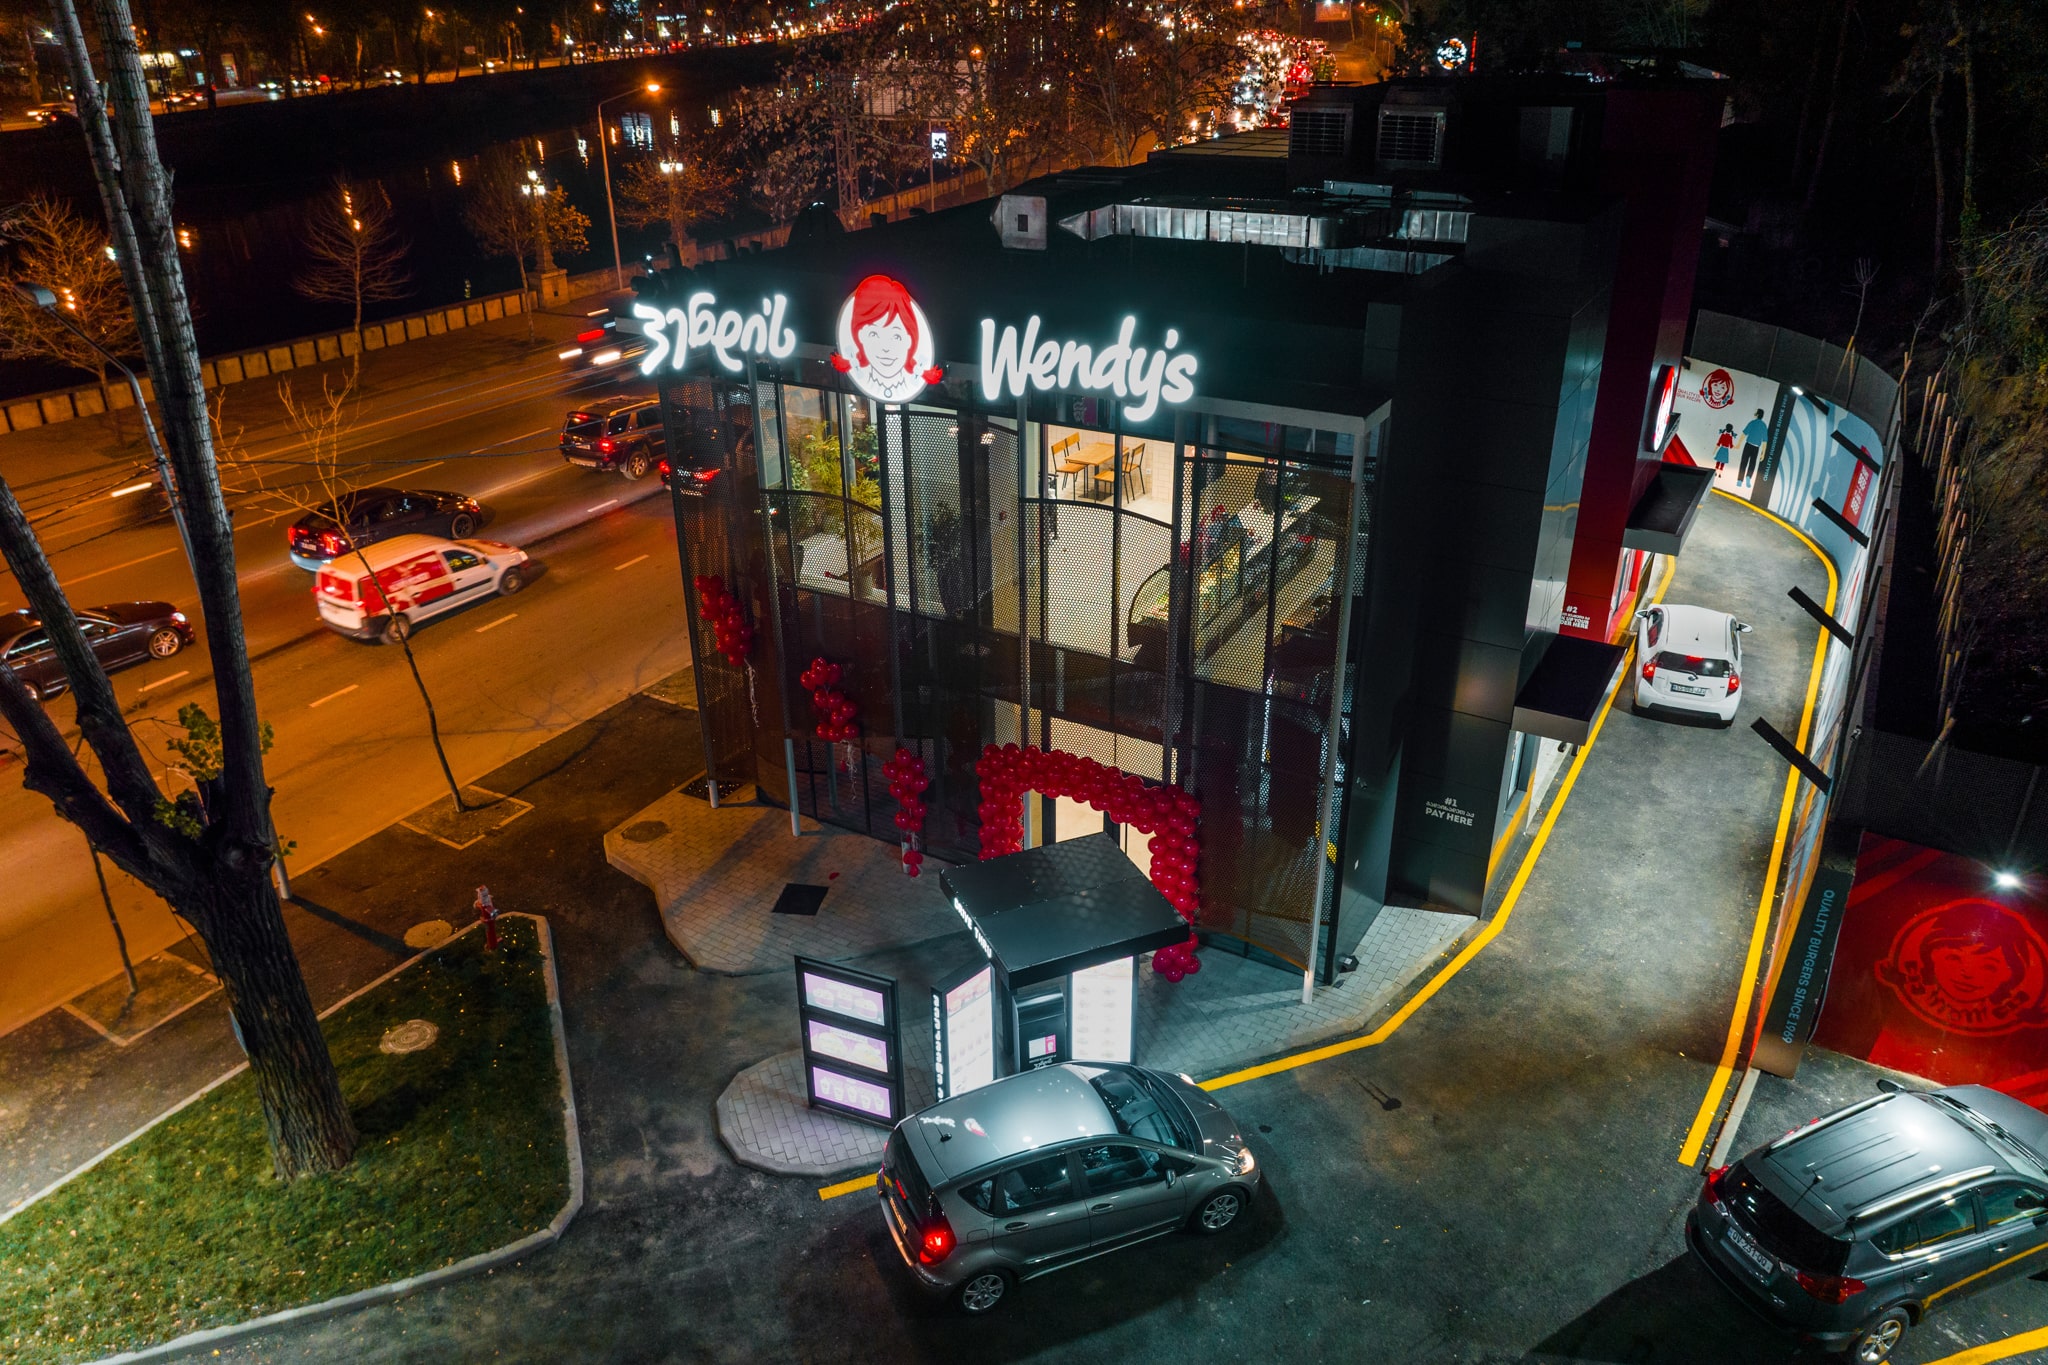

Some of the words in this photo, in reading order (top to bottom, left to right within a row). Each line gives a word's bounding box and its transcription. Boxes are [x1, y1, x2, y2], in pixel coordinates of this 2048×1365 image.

[981, 315, 1198, 423] Wendy's
[1763, 455, 1773, 481] QUALITY
[1776, 408, 1785, 428] SINCE
[1566, 605, 1578, 614] #2
[1425, 807, 1446, 818] PAY
[1446, 813, 1473, 826] HERE
[1444, 797, 1457, 807] #1
[954, 897, 973, 930] DRIVE
[974, 926, 992, 958] THRU
[1813, 889, 1835, 937] QUALITY
[1798, 937, 1822, 986] BURGERS
[1788, 986, 1807, 1020] SINCE
[1782, 1019, 1798, 1044] 1969
